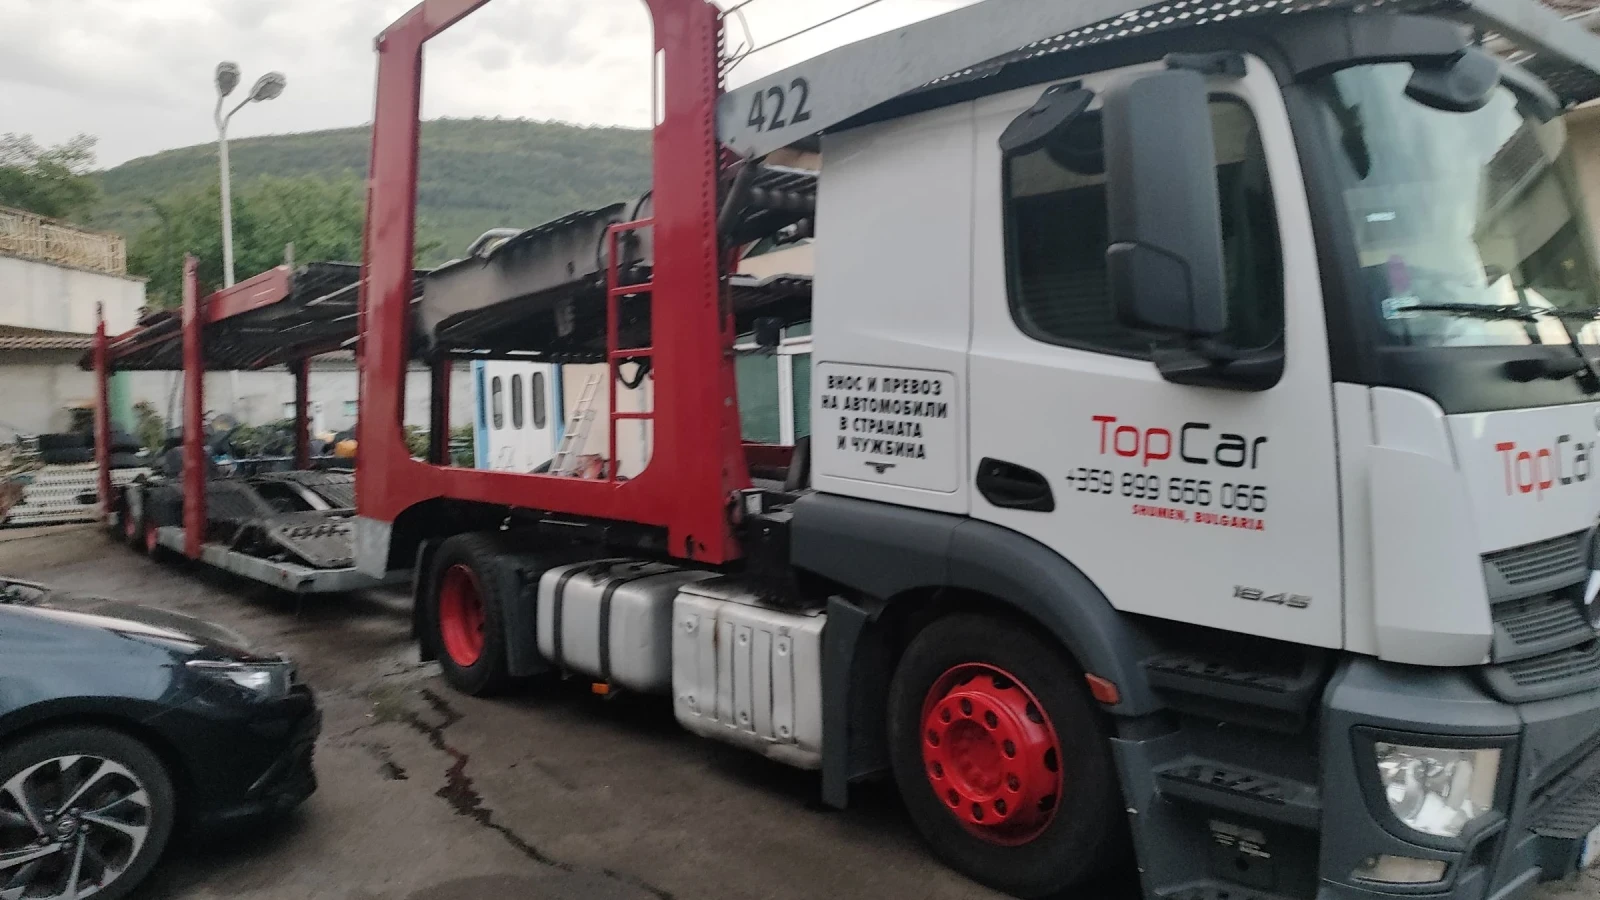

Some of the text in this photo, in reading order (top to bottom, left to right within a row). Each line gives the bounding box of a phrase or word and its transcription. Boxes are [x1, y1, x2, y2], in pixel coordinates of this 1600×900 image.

[746, 77, 812, 133] 422
[827, 375, 942, 396] ВНОС И ПРЕВОЗ
[821, 394, 948, 418] НА АВТОМОБИЛИ
[839, 416, 923, 438] В СТРАНАТА
[837, 435, 927, 460] И ЧУЖБИНА
[1091, 415, 1268, 469] TopCar
[1065, 467, 1267, 513] +359 899 666 066
[1132, 503, 1265, 531] SHUMEN, BULGARIA
